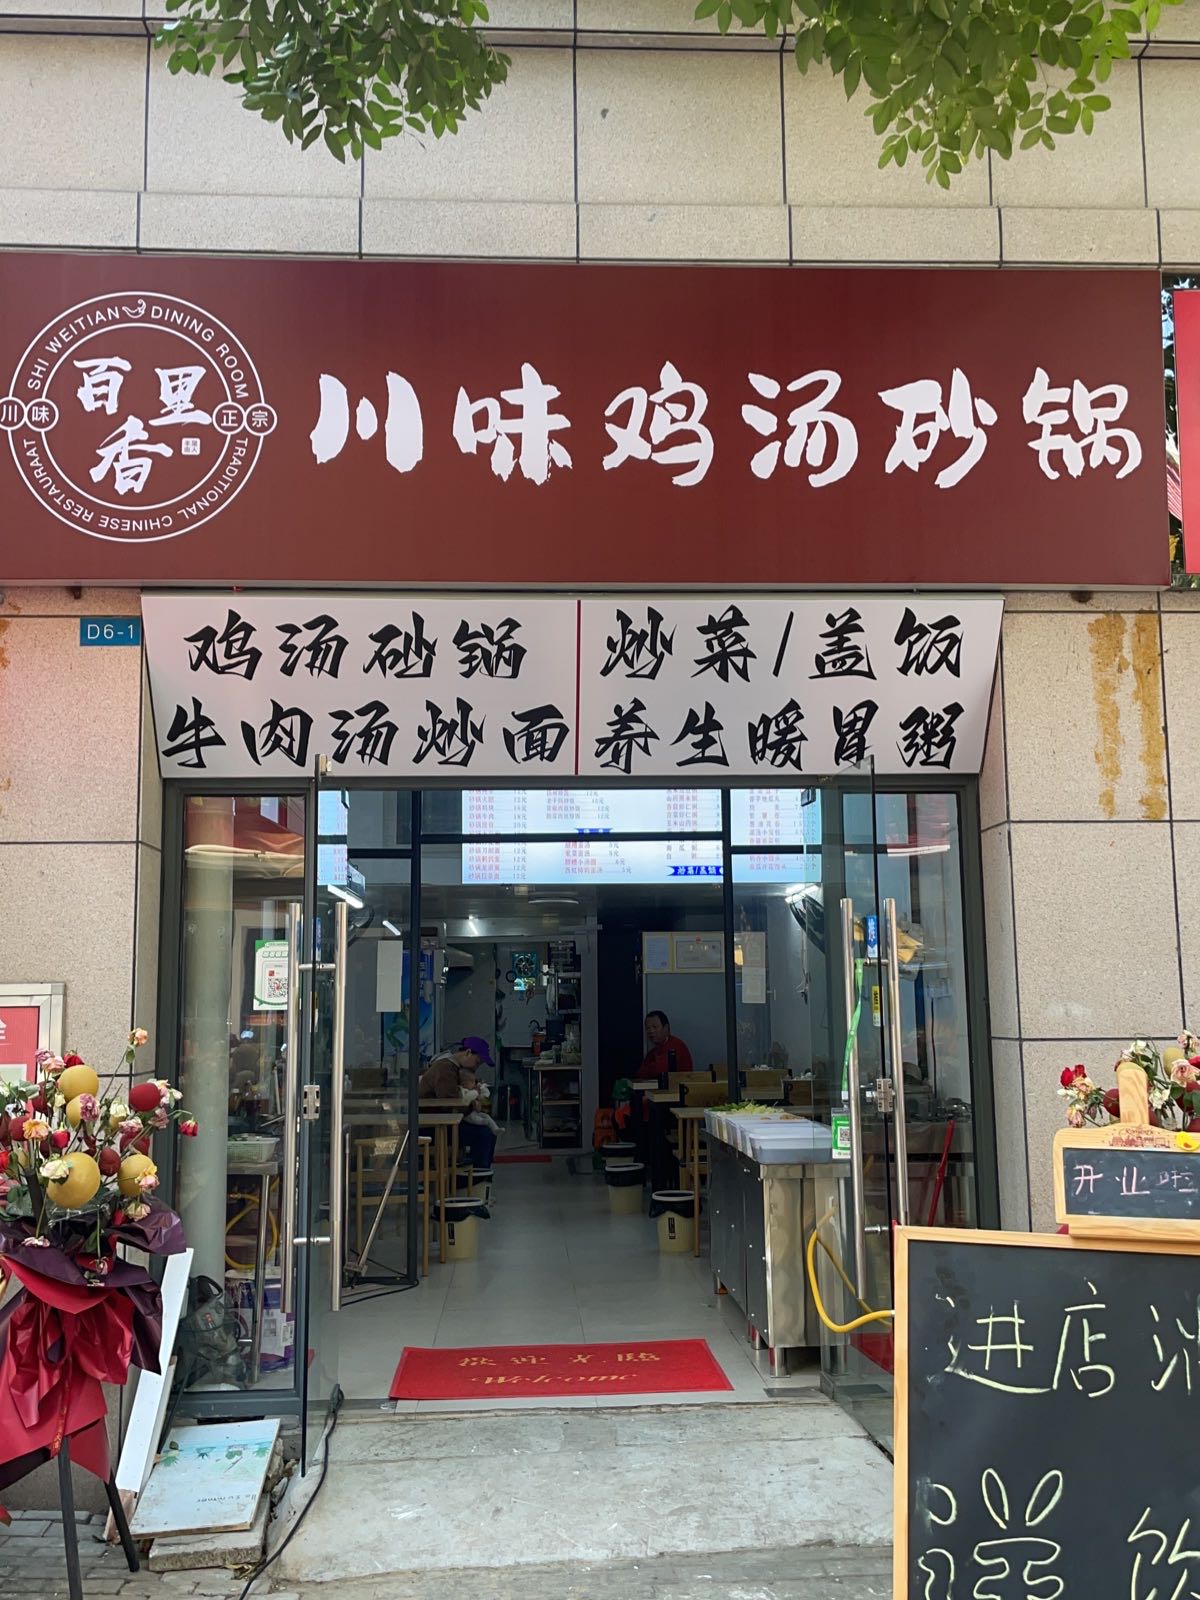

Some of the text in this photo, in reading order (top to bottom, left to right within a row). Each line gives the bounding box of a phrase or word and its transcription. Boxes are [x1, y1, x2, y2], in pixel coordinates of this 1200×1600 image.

[28, 306, 249, 398] SHI WEITIAN DINING ROOM
[221, 409, 268, 428] 正宗
[310, 362, 1142, 488] 川味鸡汤砂锅
[177, 437, 248, 520] TRADITIONAL
[98, 514, 173, 531] CHINESE
[87, 624, 133, 640] D6-1
[184, 610, 527, 681] 鸡汤砂锅
[600, 605, 965, 682] 炒菜/盖饭
[162, 697, 570, 767] 牛肉汤炒面
[595, 698, 966, 774] 养生暖胃粥
